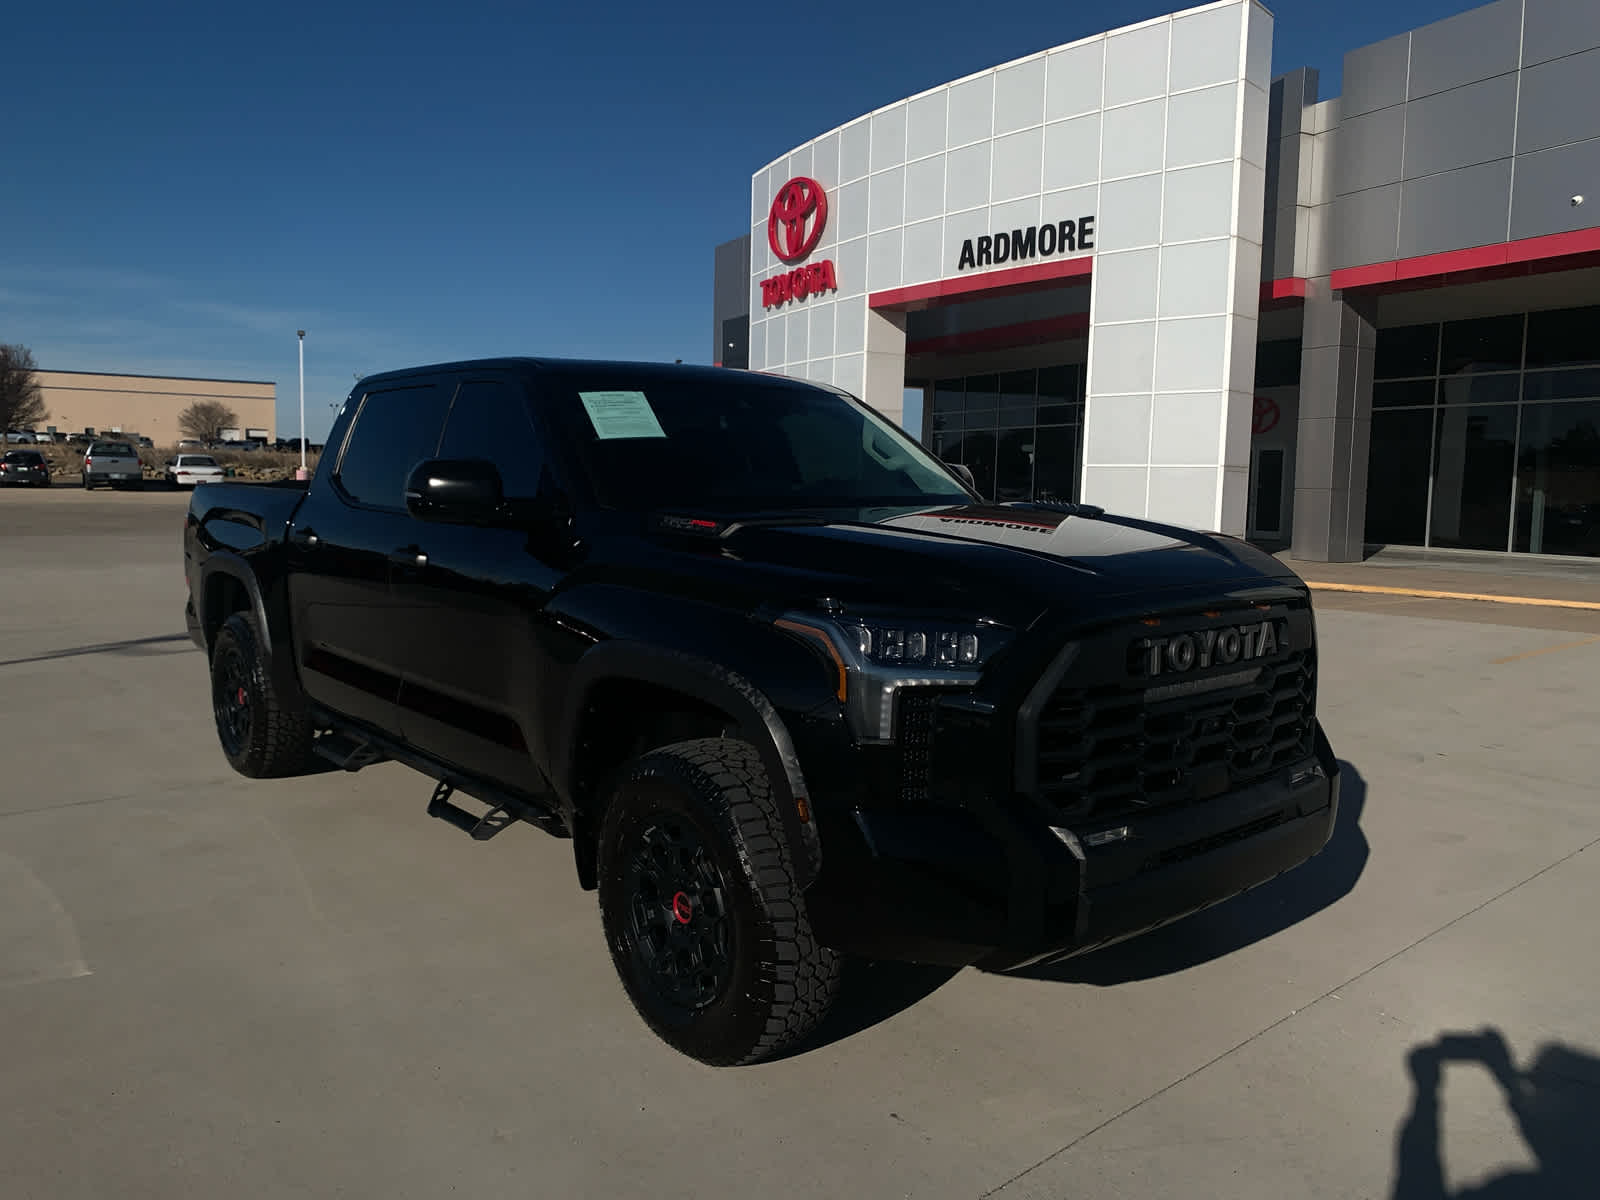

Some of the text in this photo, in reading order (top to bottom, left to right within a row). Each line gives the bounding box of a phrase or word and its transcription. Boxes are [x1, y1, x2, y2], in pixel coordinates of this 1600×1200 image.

[958, 216, 1095, 270] ARDMORE
[760, 260, 837, 310] TOYOTA
[1145, 620, 1280, 676] TOYOTA
